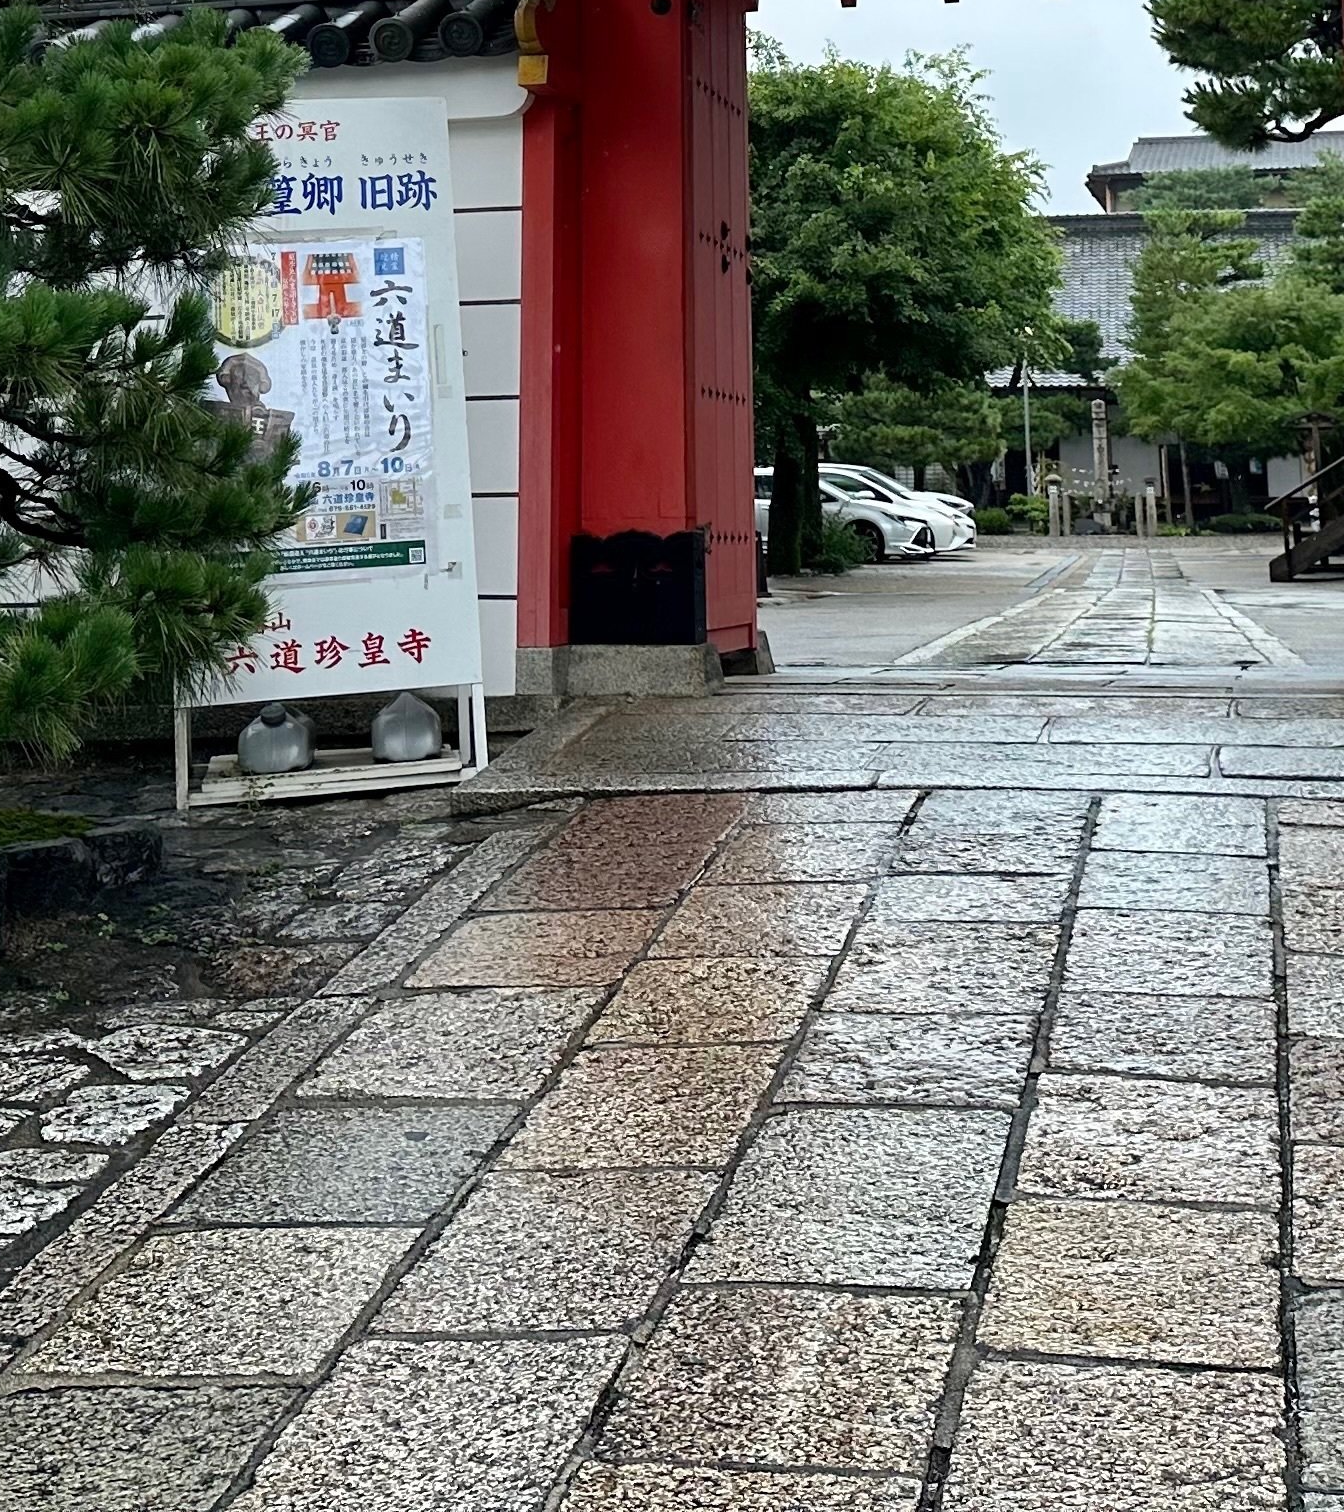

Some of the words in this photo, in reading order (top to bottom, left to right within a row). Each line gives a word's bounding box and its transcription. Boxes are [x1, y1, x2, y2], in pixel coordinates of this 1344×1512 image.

[255, 119, 341, 143] 王の冥官
[360, 152, 429, 167] きゅうせき
[358, 169, 438, 212] 旧跡
[369, 279, 420, 453] 六道まいり
[322, 492, 375, 505] 六道珍皇寺
[223, 628, 432, 674] 六道珍皇寺
